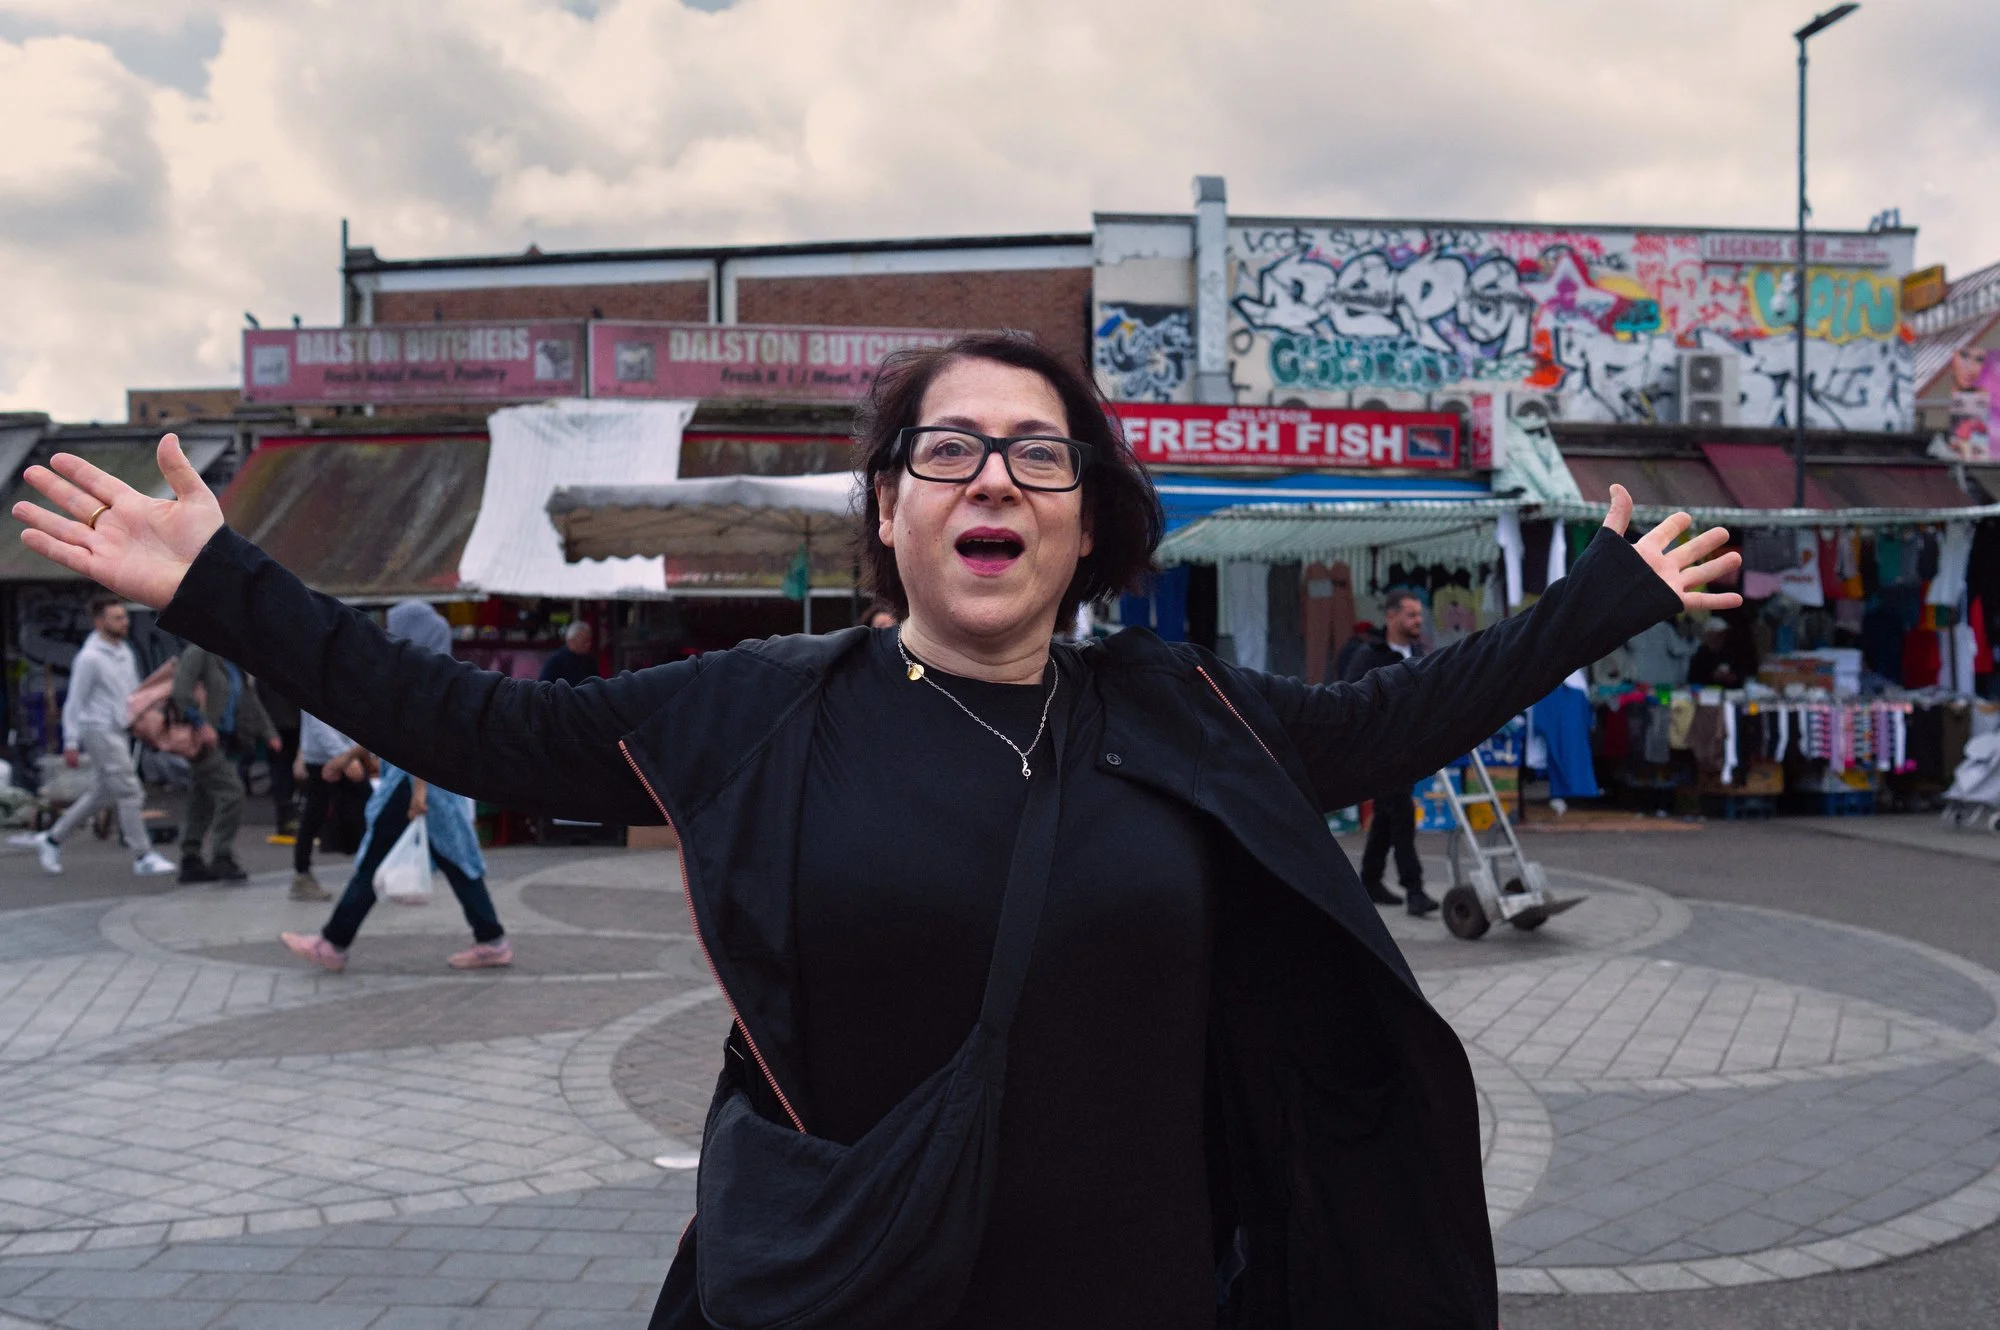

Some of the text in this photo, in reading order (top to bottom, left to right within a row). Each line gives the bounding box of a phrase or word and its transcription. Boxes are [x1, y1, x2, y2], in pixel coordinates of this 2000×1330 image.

[296, 328, 530, 364] DALSTON BUTCHERS
[668, 330, 800, 365] DALSTON
[1120, 416, 1280, 454] FRESH
[1297, 422, 1405, 463] FISH
